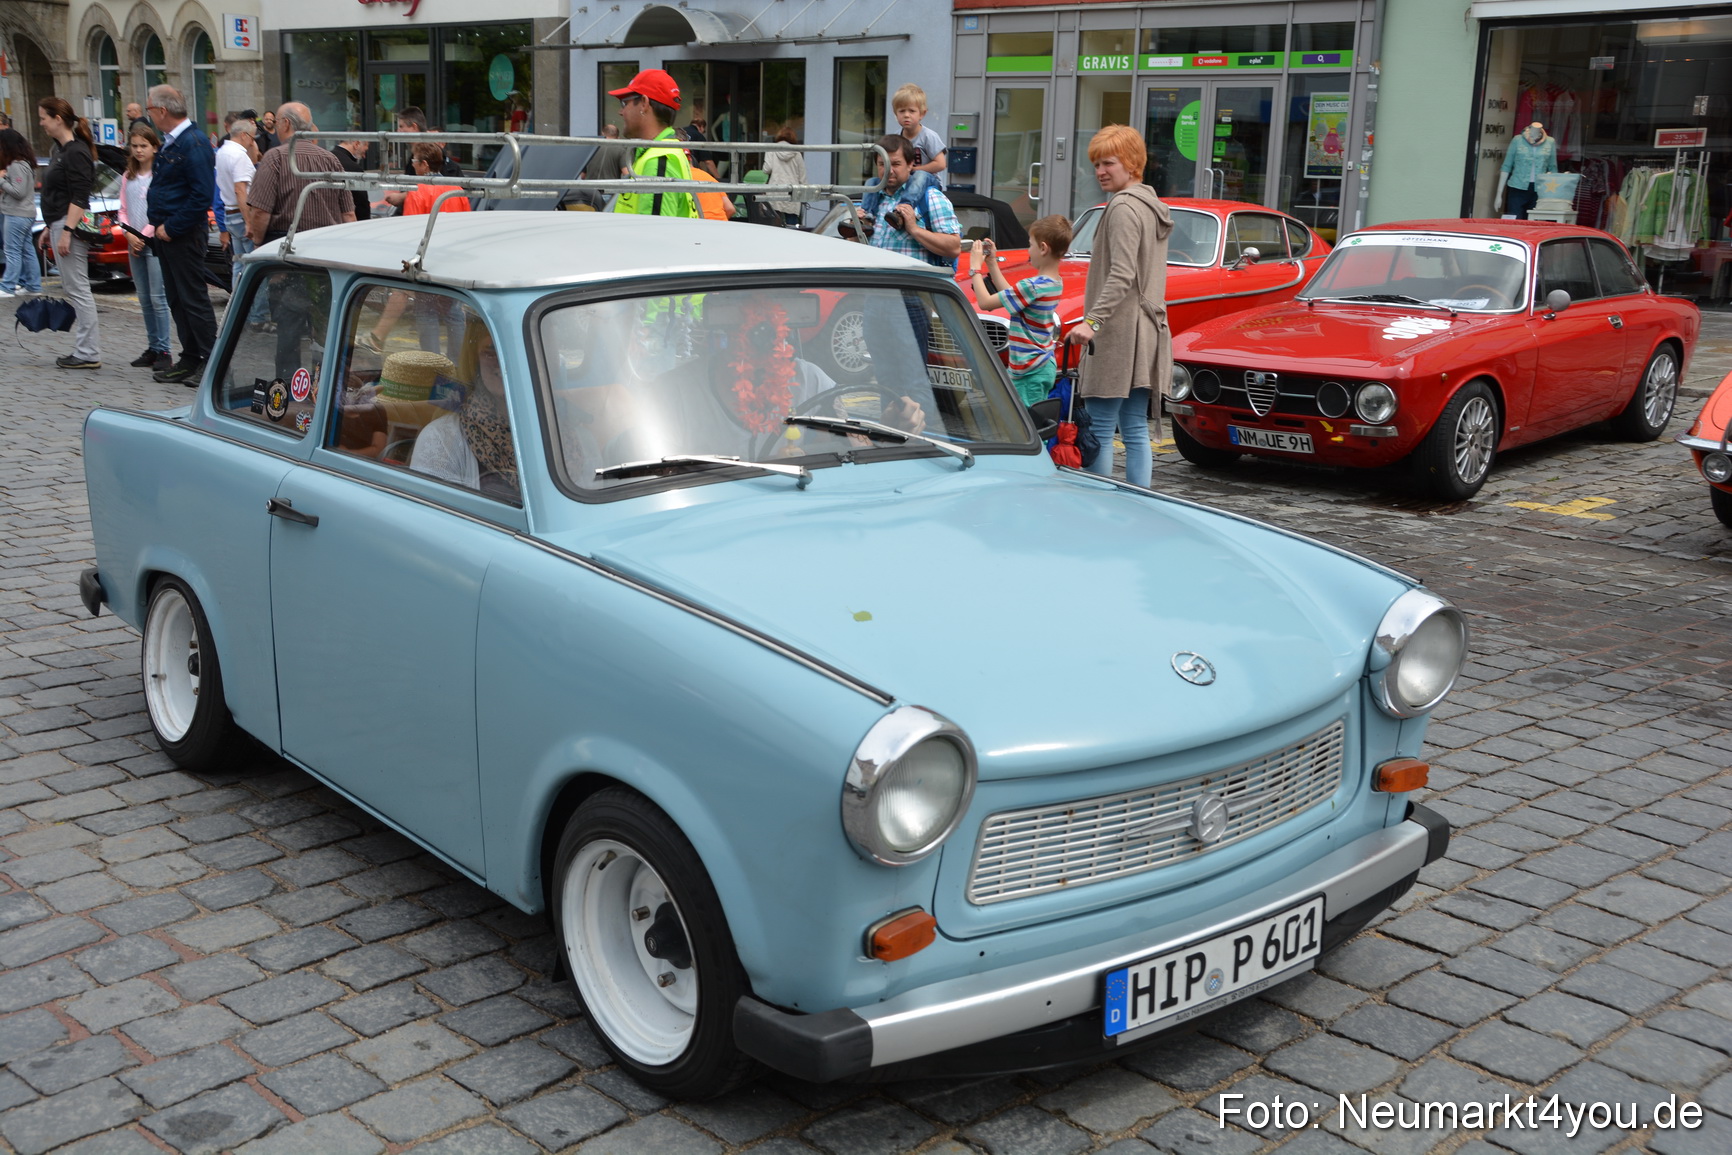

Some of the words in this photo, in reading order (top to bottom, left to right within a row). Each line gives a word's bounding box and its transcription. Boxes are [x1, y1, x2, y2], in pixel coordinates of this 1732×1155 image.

[1083, 56, 1129, 69] GRAVIS
[293, 371, 308, 395] STP
[1237, 429, 1258, 443] NM
[1265, 433, 1287, 449] UE
[1289, 436, 1311, 451] 9H
[1131, 951, 1206, 1021] HIP
[1233, 934, 1253, 983] P
[1262, 906, 1318, 970] 601
[1111, 1008, 1121, 1023] D
